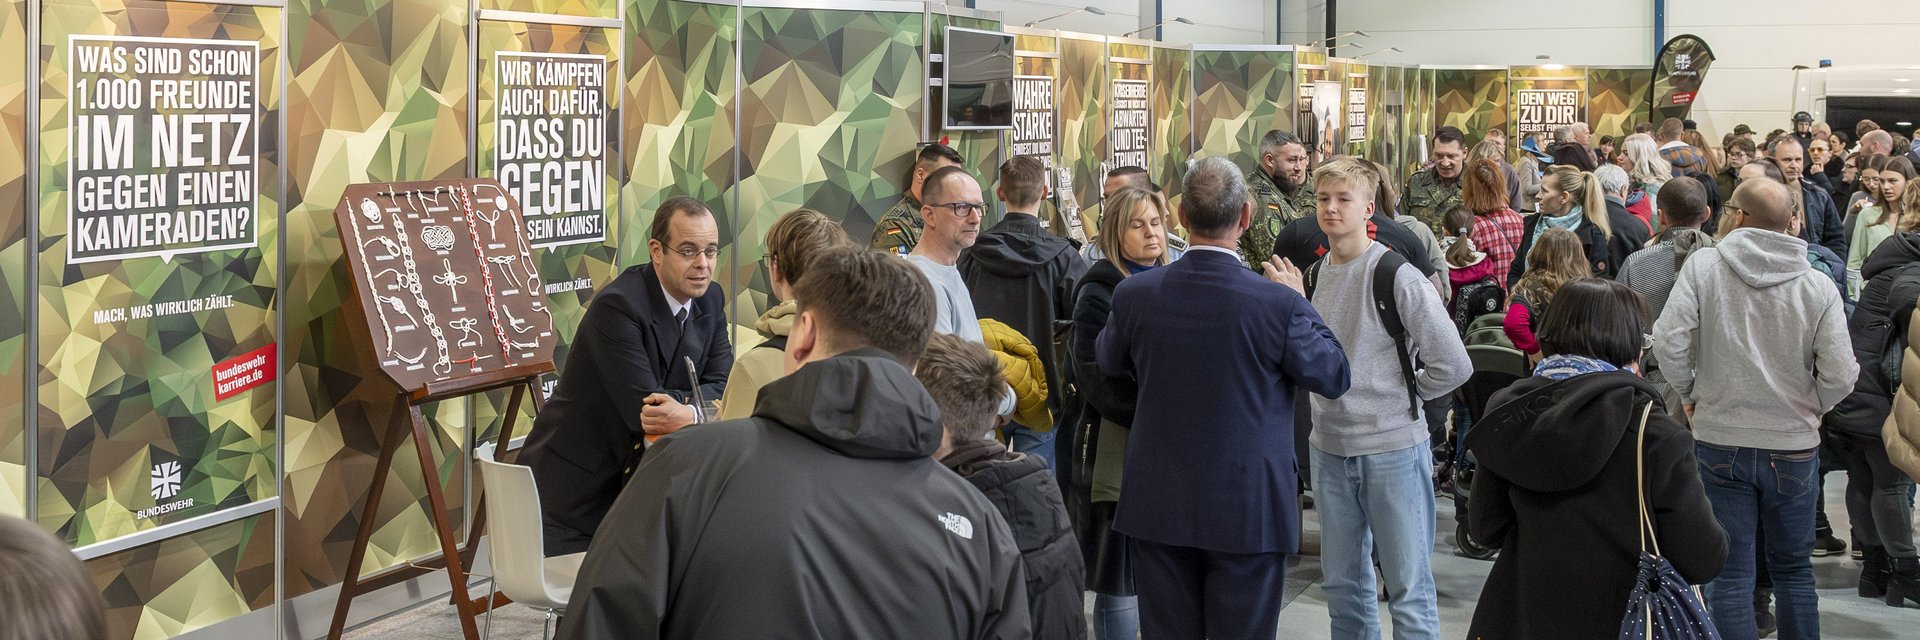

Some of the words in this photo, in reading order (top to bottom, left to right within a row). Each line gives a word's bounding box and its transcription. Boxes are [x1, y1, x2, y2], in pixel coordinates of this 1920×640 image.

[77, 45, 127, 74] WAS
[134, 46, 182, 74] SIND
[188, 48, 251, 76] SCHON
[500, 60, 532, 86] WIR
[536, 58, 602, 87] KÄMPFEN
[76, 78, 142, 109] 1.000
[150, 79, 251, 109] FREUNDE
[500, 88, 544, 116] AUCH
[549, 86, 602, 119] DAFÜR,
[1013, 79, 1051, 110] WAHRE
[1520, 92, 1544, 106] DEN
[1546, 92, 1575, 105] WEG
[1013, 109, 1051, 141] STÄRKE
[1114, 109, 1147, 127] ABWARTEN
[1520, 105, 1542, 124] ZU
[1545, 105, 1575, 124] DIR
[1520, 123, 1545, 132] SELBST
[77, 114, 134, 171] IM
[151, 113, 251, 168] NETZ
[500, 117, 564, 160] DASS
[572, 118, 602, 158] DU
[1114, 128, 1131, 151] UND
[1131, 128, 1147, 150] TEE-
[77, 173, 167, 213] GEGEN
[177, 170, 250, 206] EINEN
[77, 206, 250, 252] KAMERADEN?
[527, 218, 553, 240] SEIN
[556, 214, 602, 237] KANNST.
[544, 280, 573, 295] WIRKLICH
[573, 277, 593, 290] ZÄHLT.
[93, 308, 128, 325] MACH,
[130, 304, 153, 320] WAS
[155, 298, 203, 316] WIRKLICH
[204, 293, 235, 310] ZÄHLT.
[215, 353, 267, 382] bundeswehr
[217, 369, 263, 395] karriere.de
[137, 498, 194, 520] BUNDESWEHR
